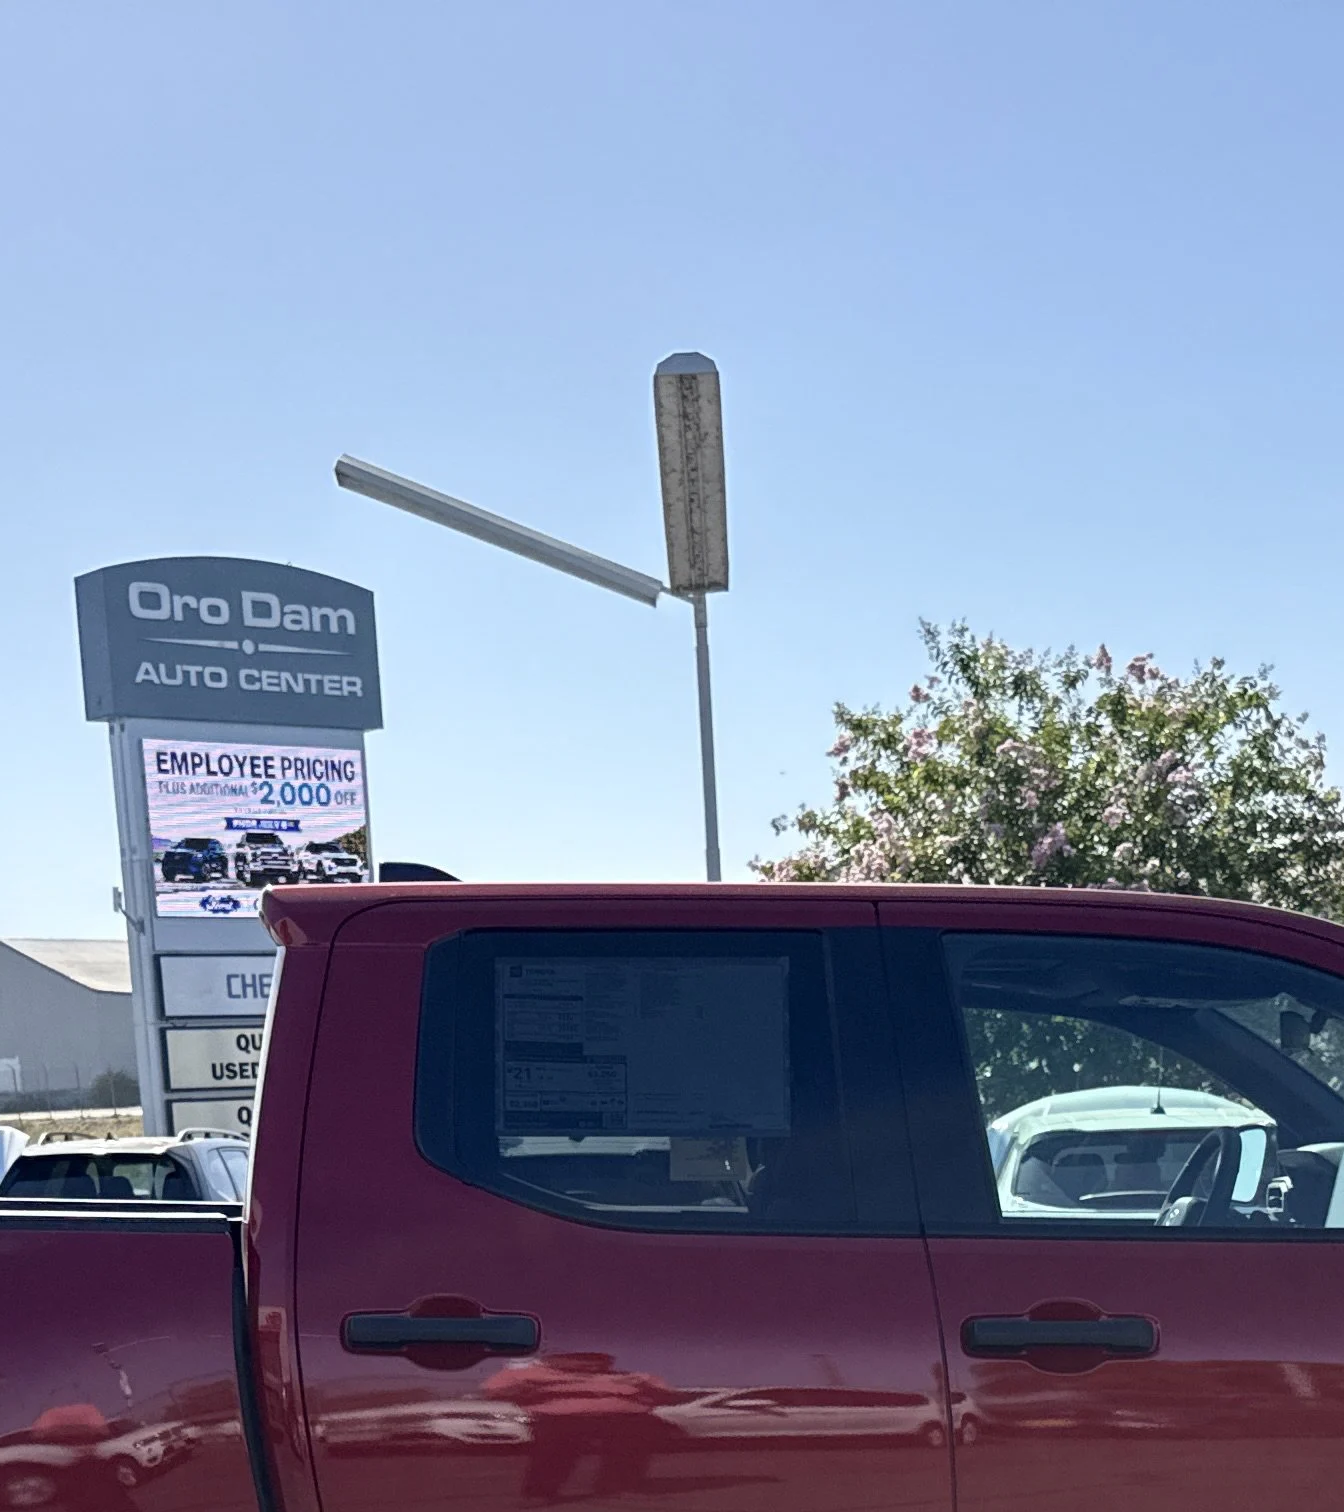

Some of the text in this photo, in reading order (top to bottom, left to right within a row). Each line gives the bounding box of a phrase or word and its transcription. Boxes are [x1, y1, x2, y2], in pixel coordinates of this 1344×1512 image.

[128, 580, 356, 635] Oro Dam
[134, 661, 364, 697] AUTO CENTER
[156, 751, 356, 782] EMPLOYEE PRICING
[334, 790, 356, 805] OFF
